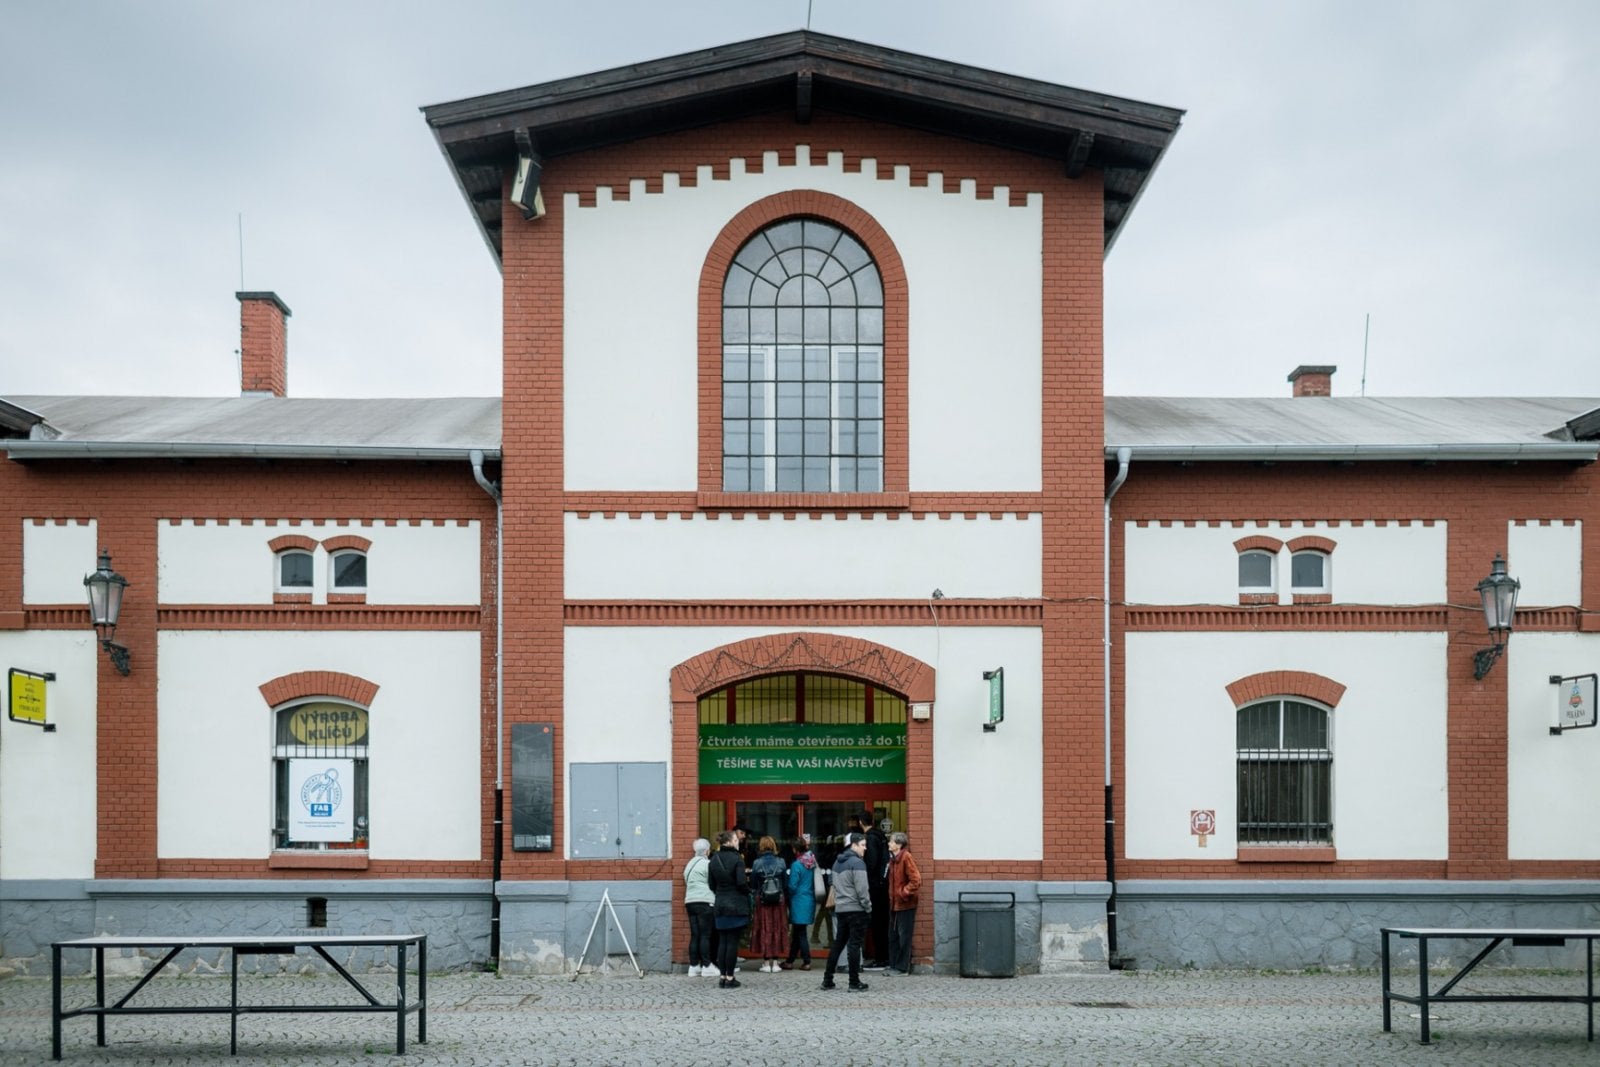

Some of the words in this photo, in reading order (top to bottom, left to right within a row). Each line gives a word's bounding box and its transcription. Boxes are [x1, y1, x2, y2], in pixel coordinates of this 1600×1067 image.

[300, 710, 360, 724] VÝROBA
[309, 724, 352, 740] KLÍČŮ
[707, 735, 752, 746] čtvrtek
[755, 735, 794, 746] máme
[797, 735, 855, 746] otevřeno
[858, 735, 872, 746] až
[876, 735, 892, 746] do
[716, 757, 757, 768] TĚŠÍME
[759, 759, 774, 768] SE
[776, 759, 793, 768] NA
[796, 757, 821, 768] VAŠI
[824, 756, 884, 768] NÁVŠTĚVU
